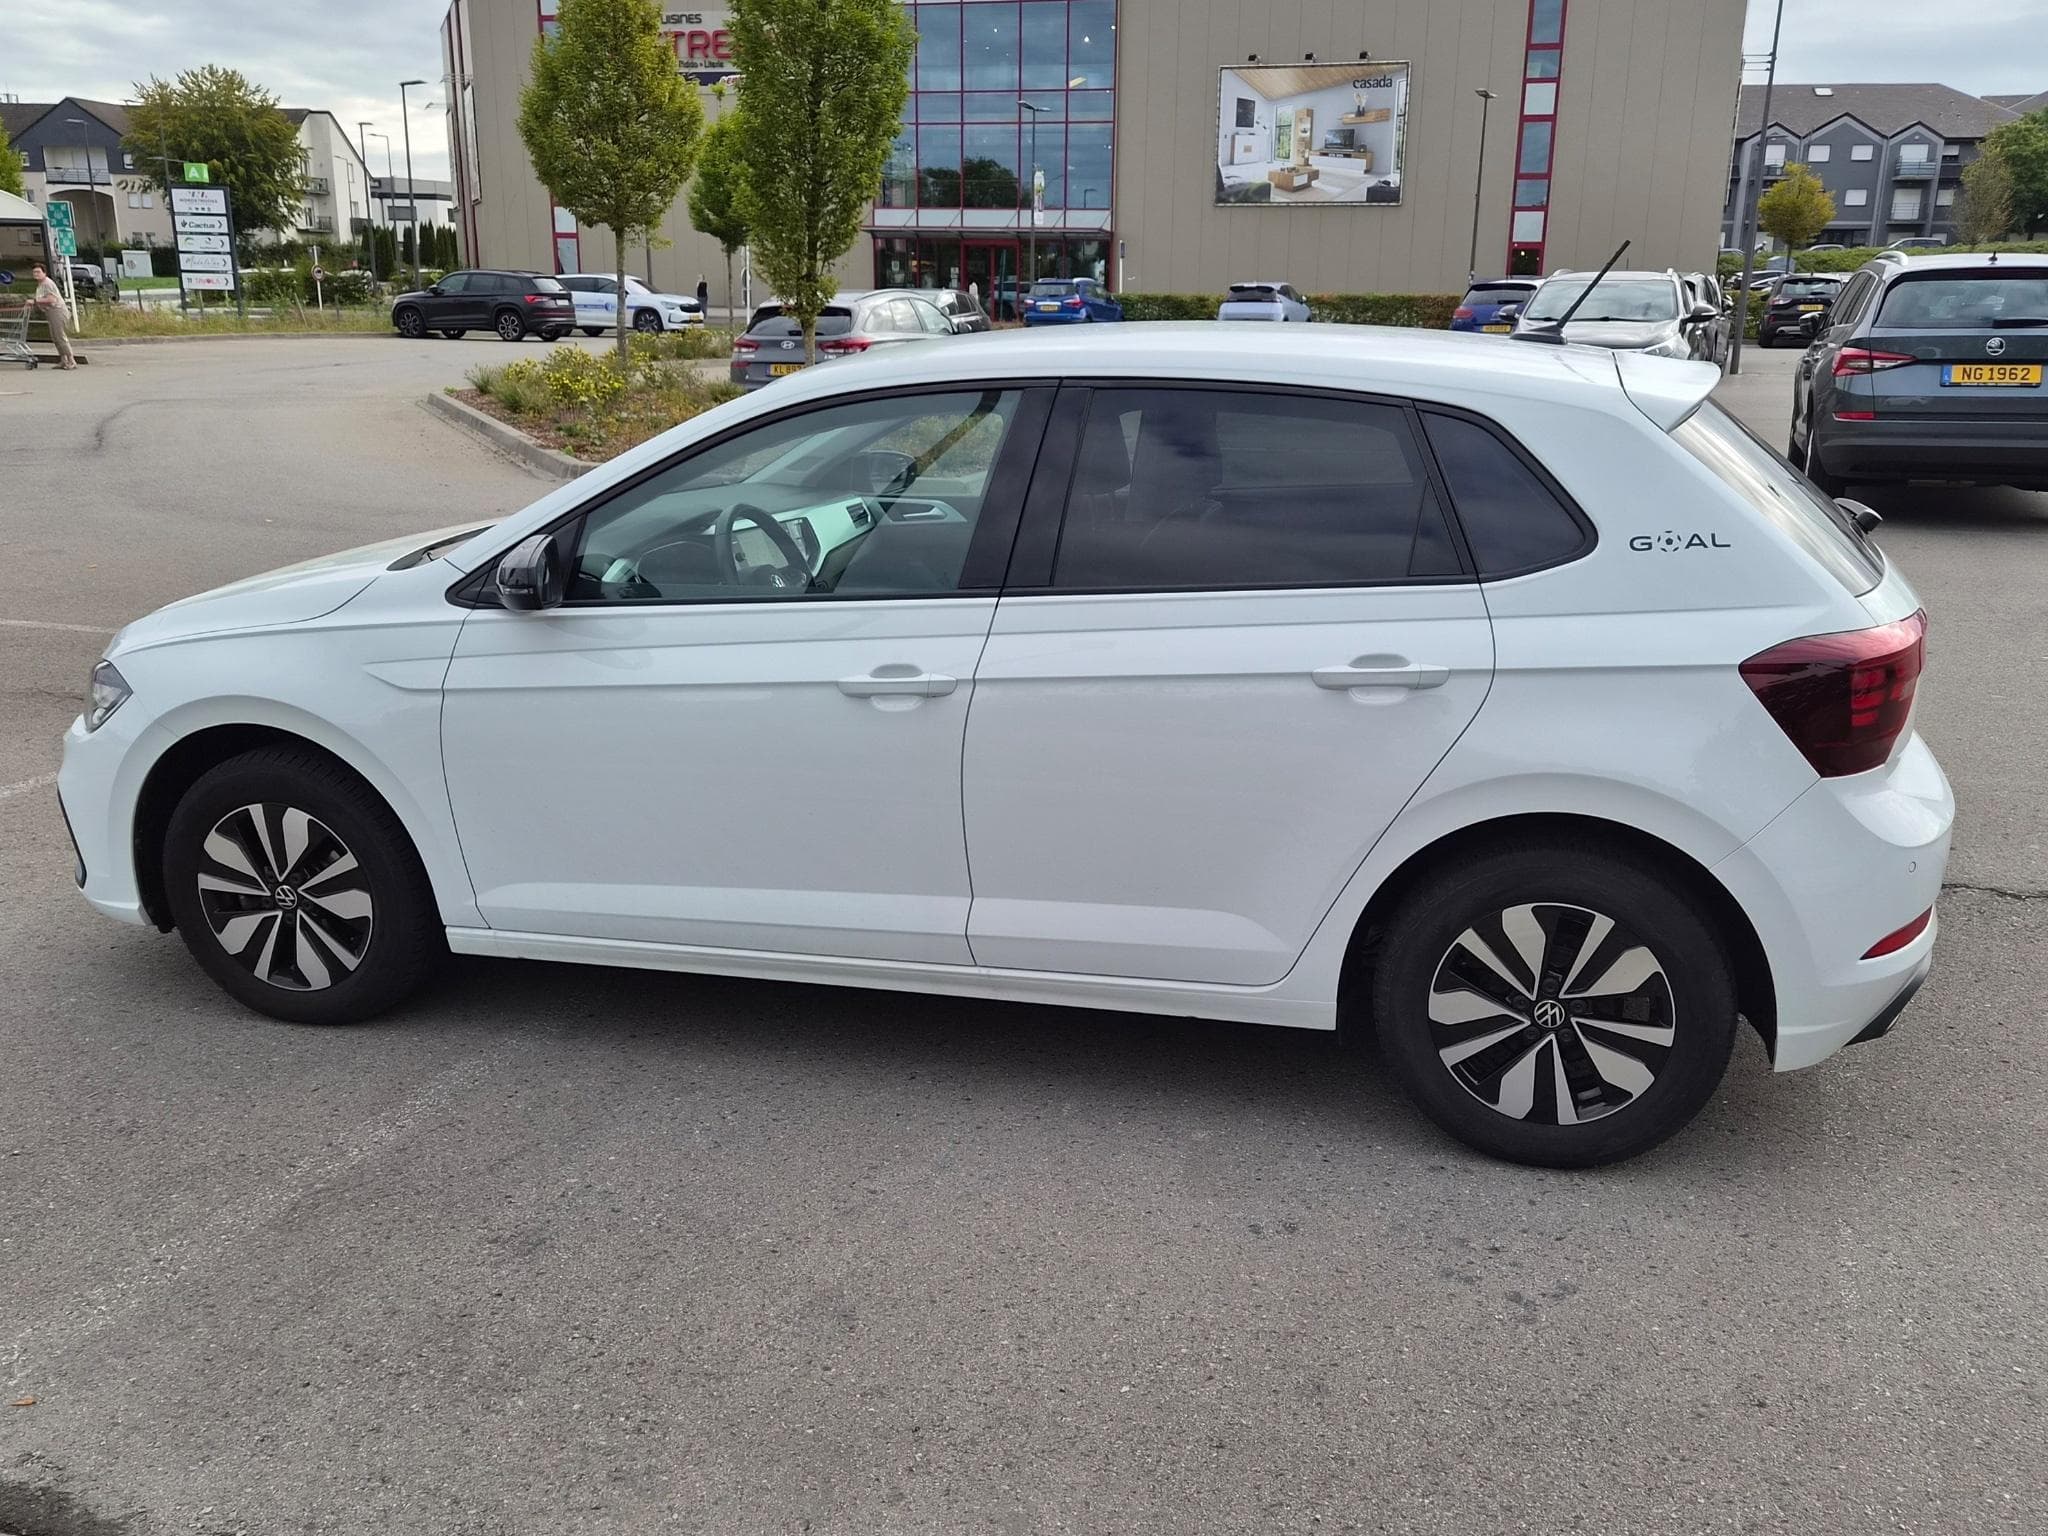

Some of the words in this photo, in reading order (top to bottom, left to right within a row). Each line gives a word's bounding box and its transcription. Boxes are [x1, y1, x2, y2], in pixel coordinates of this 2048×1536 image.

[661, 13, 702, 25] UISINES
[663, 29, 733, 60] TRE
[1352, 74, 1393, 89] casada
[188, 220, 216, 229] Cactus
[1961, 367, 1984, 381] NG
[1988, 367, 2031, 381] 1962
